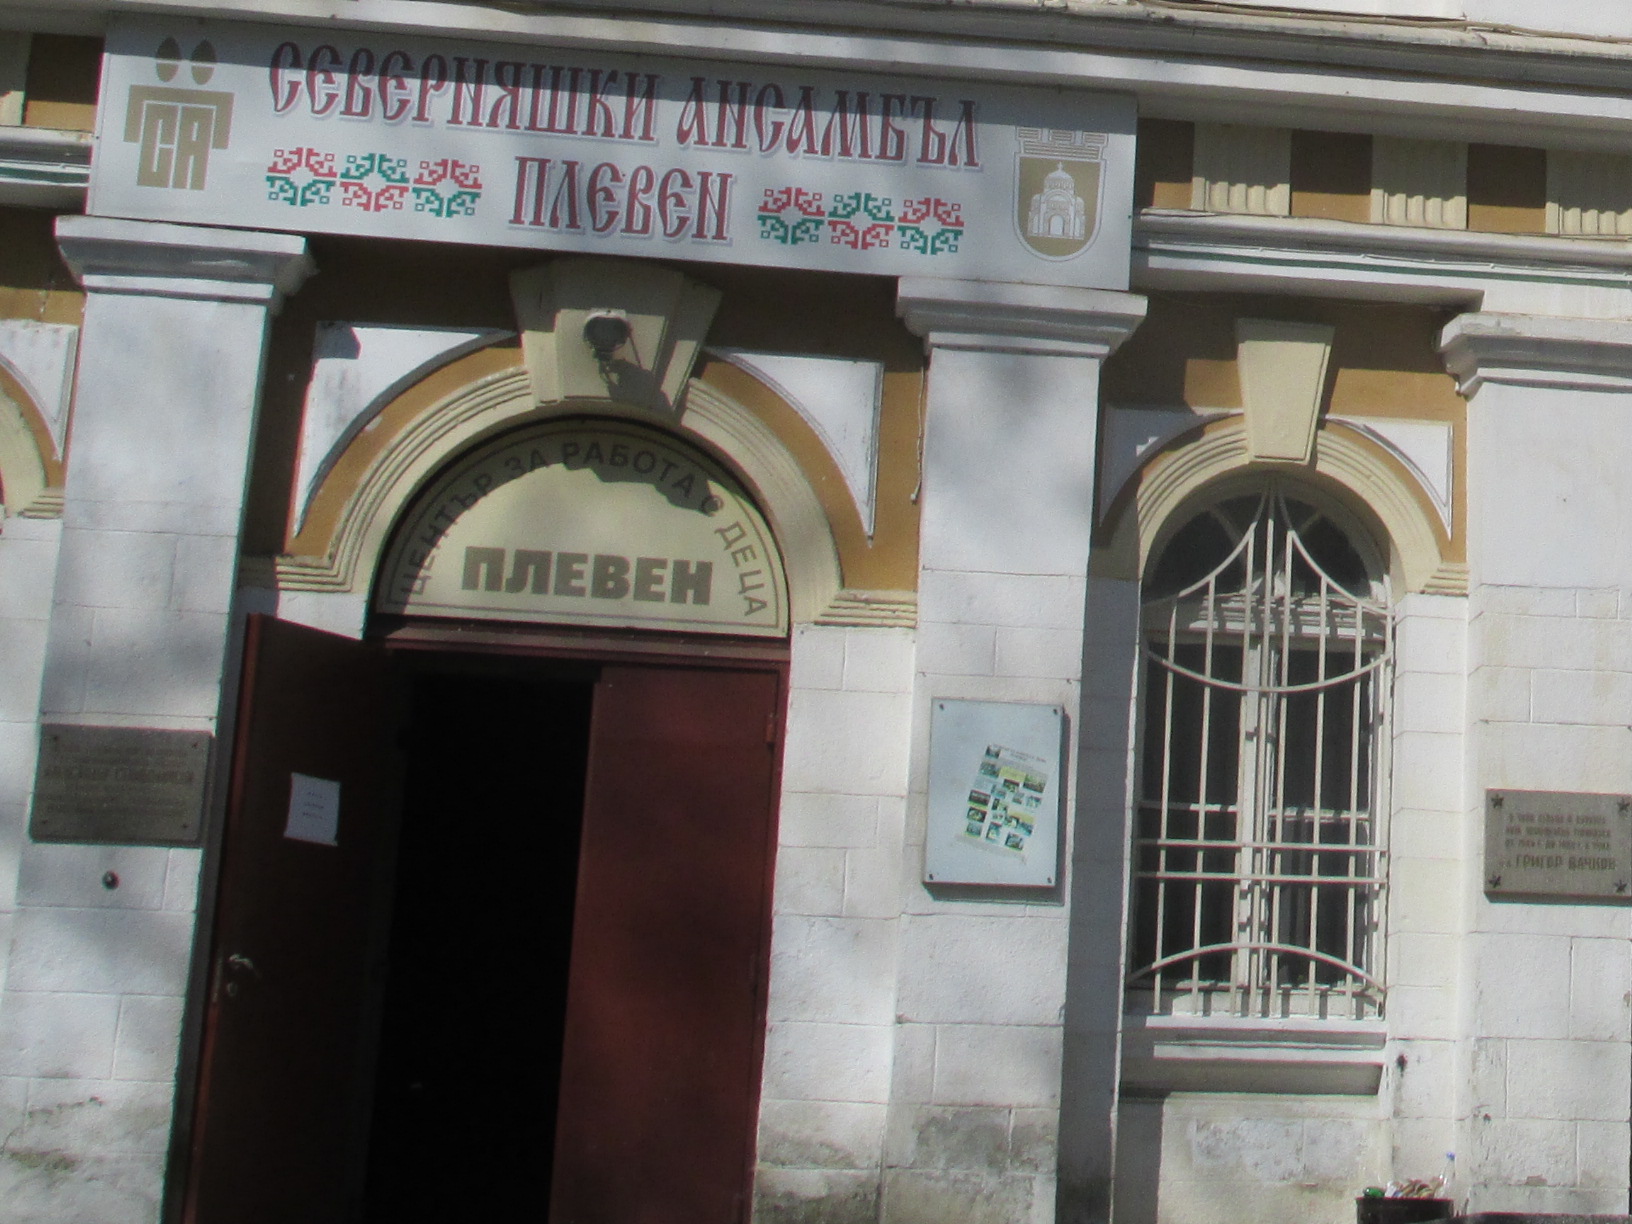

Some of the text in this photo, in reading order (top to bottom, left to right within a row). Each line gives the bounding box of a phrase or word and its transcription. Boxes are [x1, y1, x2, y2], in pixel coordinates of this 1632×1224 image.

[270, 41, 981, 168] СЕВЕРНЯШКИ АНСАМБЪЛ
[509, 155, 733, 241] ПЛЕВЕН
[400, 441, 768, 618] ЦЕНТЪР ЗА РАБОТА С ДЕЦА
[461, 545, 713, 606] ПЛЕВЕН
[1516, 854, 1563, 870] ГРИГОР
